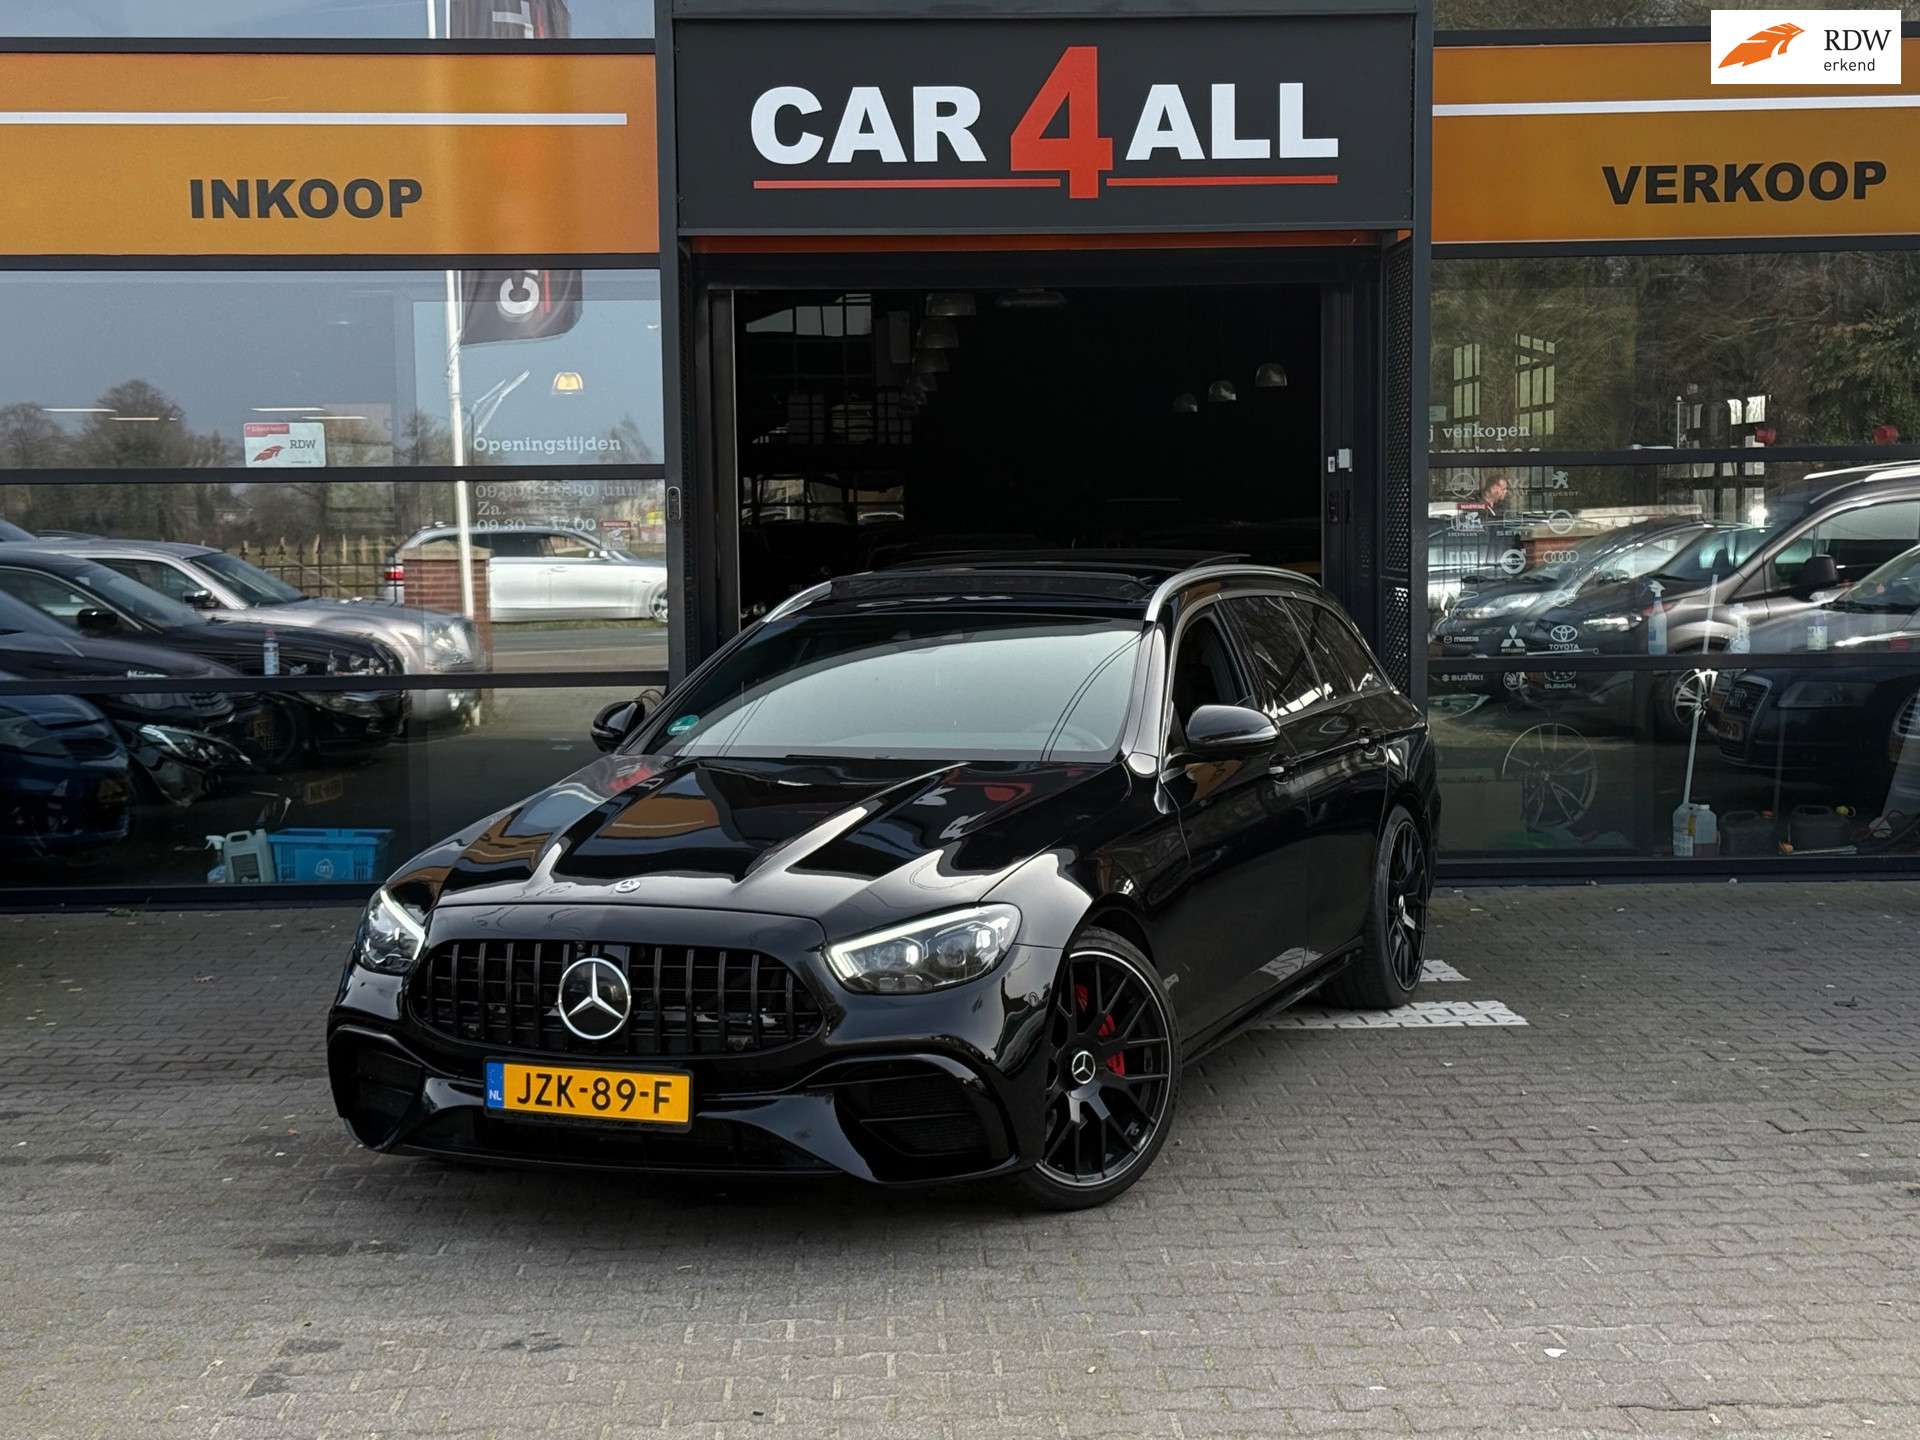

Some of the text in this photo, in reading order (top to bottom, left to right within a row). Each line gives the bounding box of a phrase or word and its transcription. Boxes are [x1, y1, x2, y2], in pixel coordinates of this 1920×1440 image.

[750, 45, 1339, 200] CAR 4 ALL
[1602, 160, 1888, 205] VERKOOP
[189, 178, 423, 219] INKOOP
[1442, 424, 1530, 441] verkopen
[289, 439, 316, 449] RDW
[473, 436, 622, 455] Openingstijden
[477, 501, 506, 516] Za.
[488, 1088, 503, 1101] NL
[516, 1071, 673, 1115] JZK-89-F
